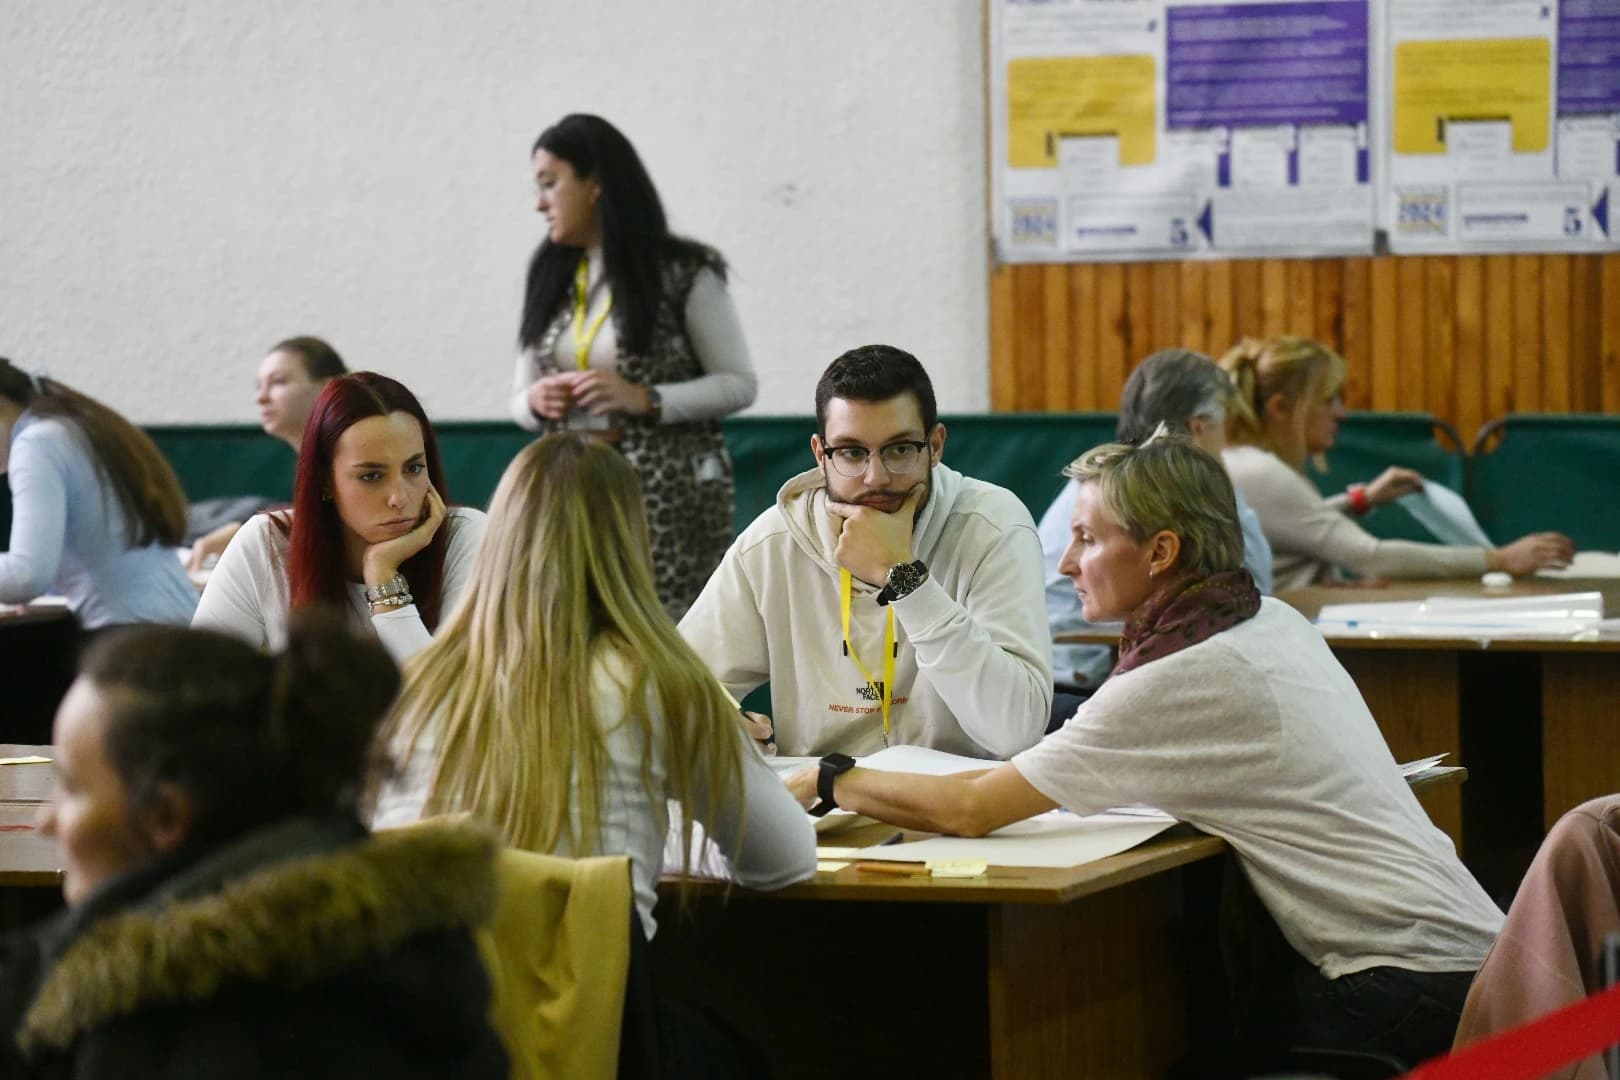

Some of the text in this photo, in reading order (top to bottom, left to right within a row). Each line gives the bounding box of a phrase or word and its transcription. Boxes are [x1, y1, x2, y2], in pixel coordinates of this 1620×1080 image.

[1170, 218, 1188, 245] 5
[1564, 206, 1582, 234] 5
[828, 703, 854, 713] NEVER
[855, 706, 875, 714] STOP
